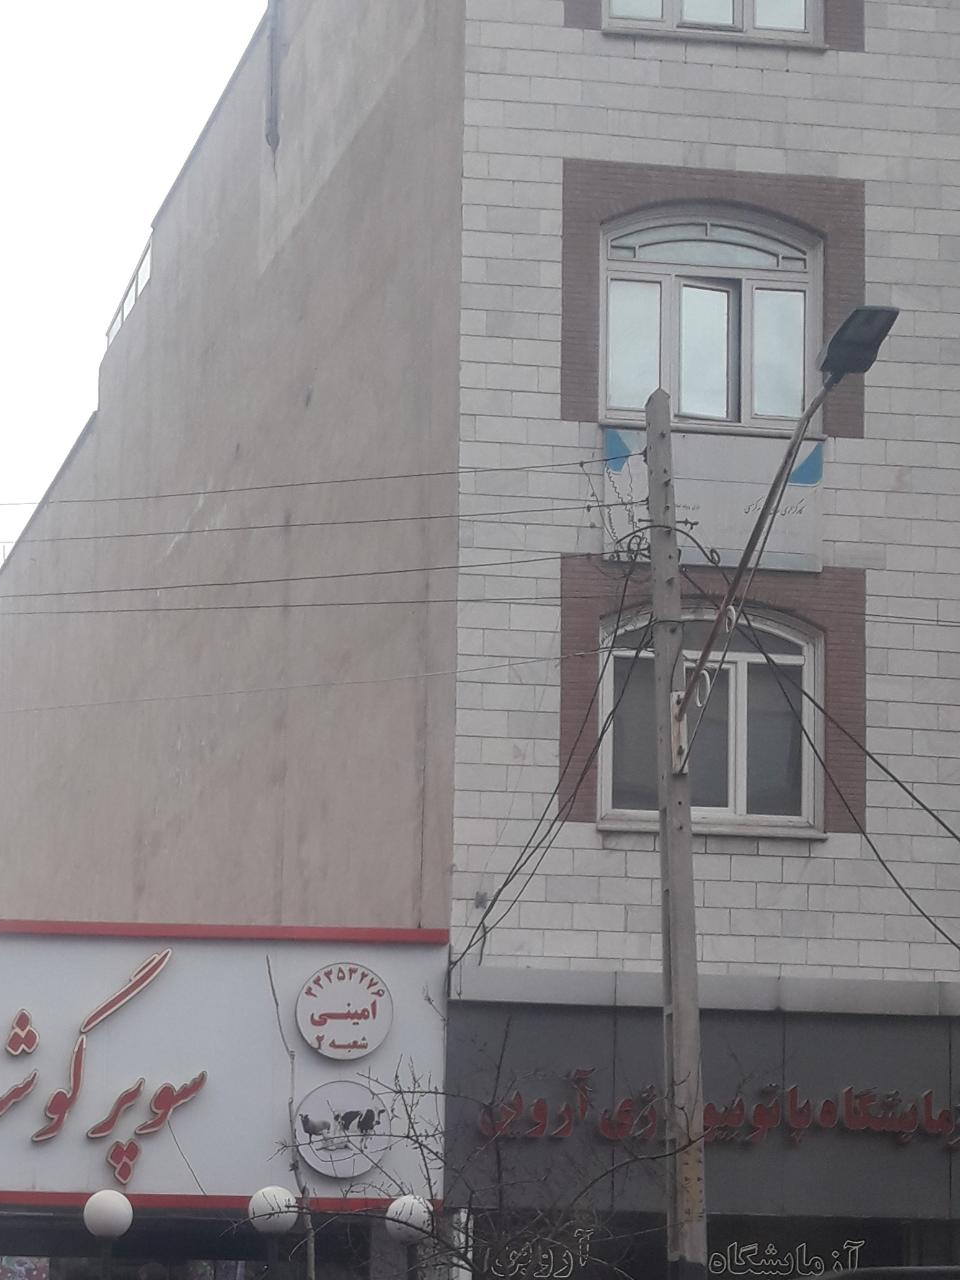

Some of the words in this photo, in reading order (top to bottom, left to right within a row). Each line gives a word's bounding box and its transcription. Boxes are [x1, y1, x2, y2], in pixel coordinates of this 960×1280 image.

[310, 999, 377, 1027] امینی
[315, 1034, 325, 1050] ۲
[329, 1036, 368, 1053] شعبه
